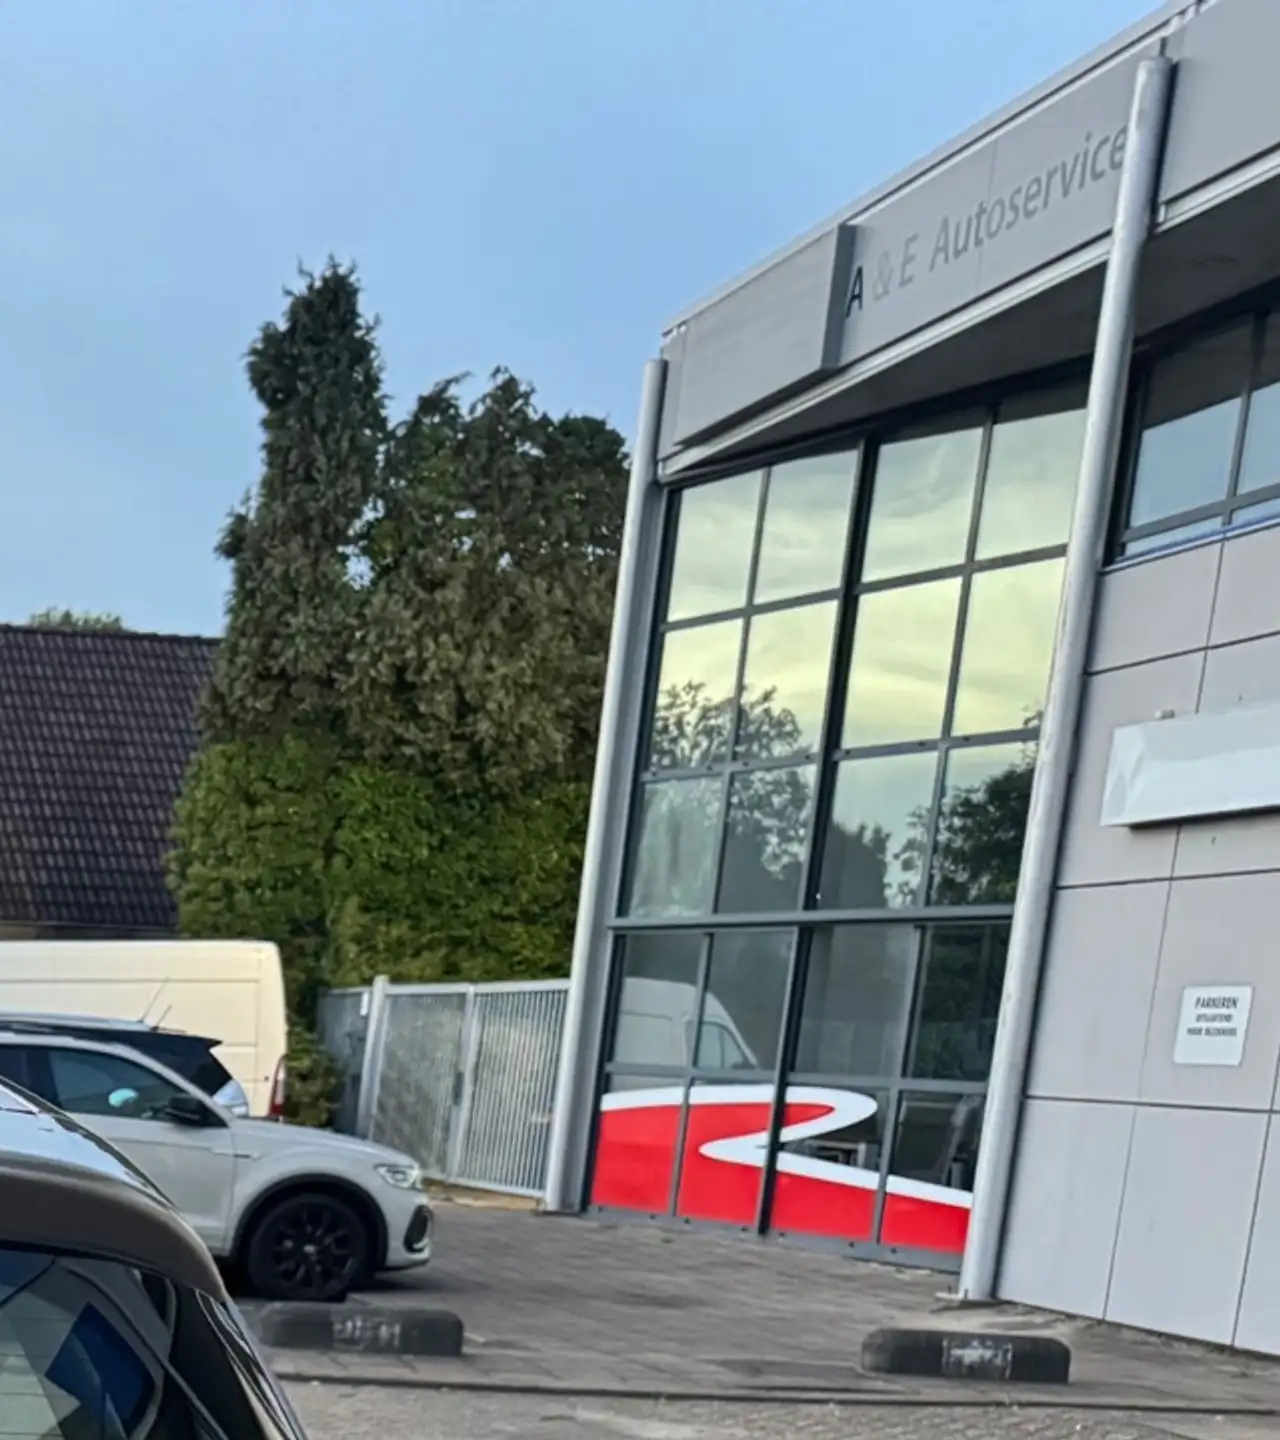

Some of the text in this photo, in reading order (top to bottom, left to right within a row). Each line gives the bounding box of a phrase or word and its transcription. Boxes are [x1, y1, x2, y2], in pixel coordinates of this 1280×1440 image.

[844, 123, 1129, 318] A & E Autoservice
